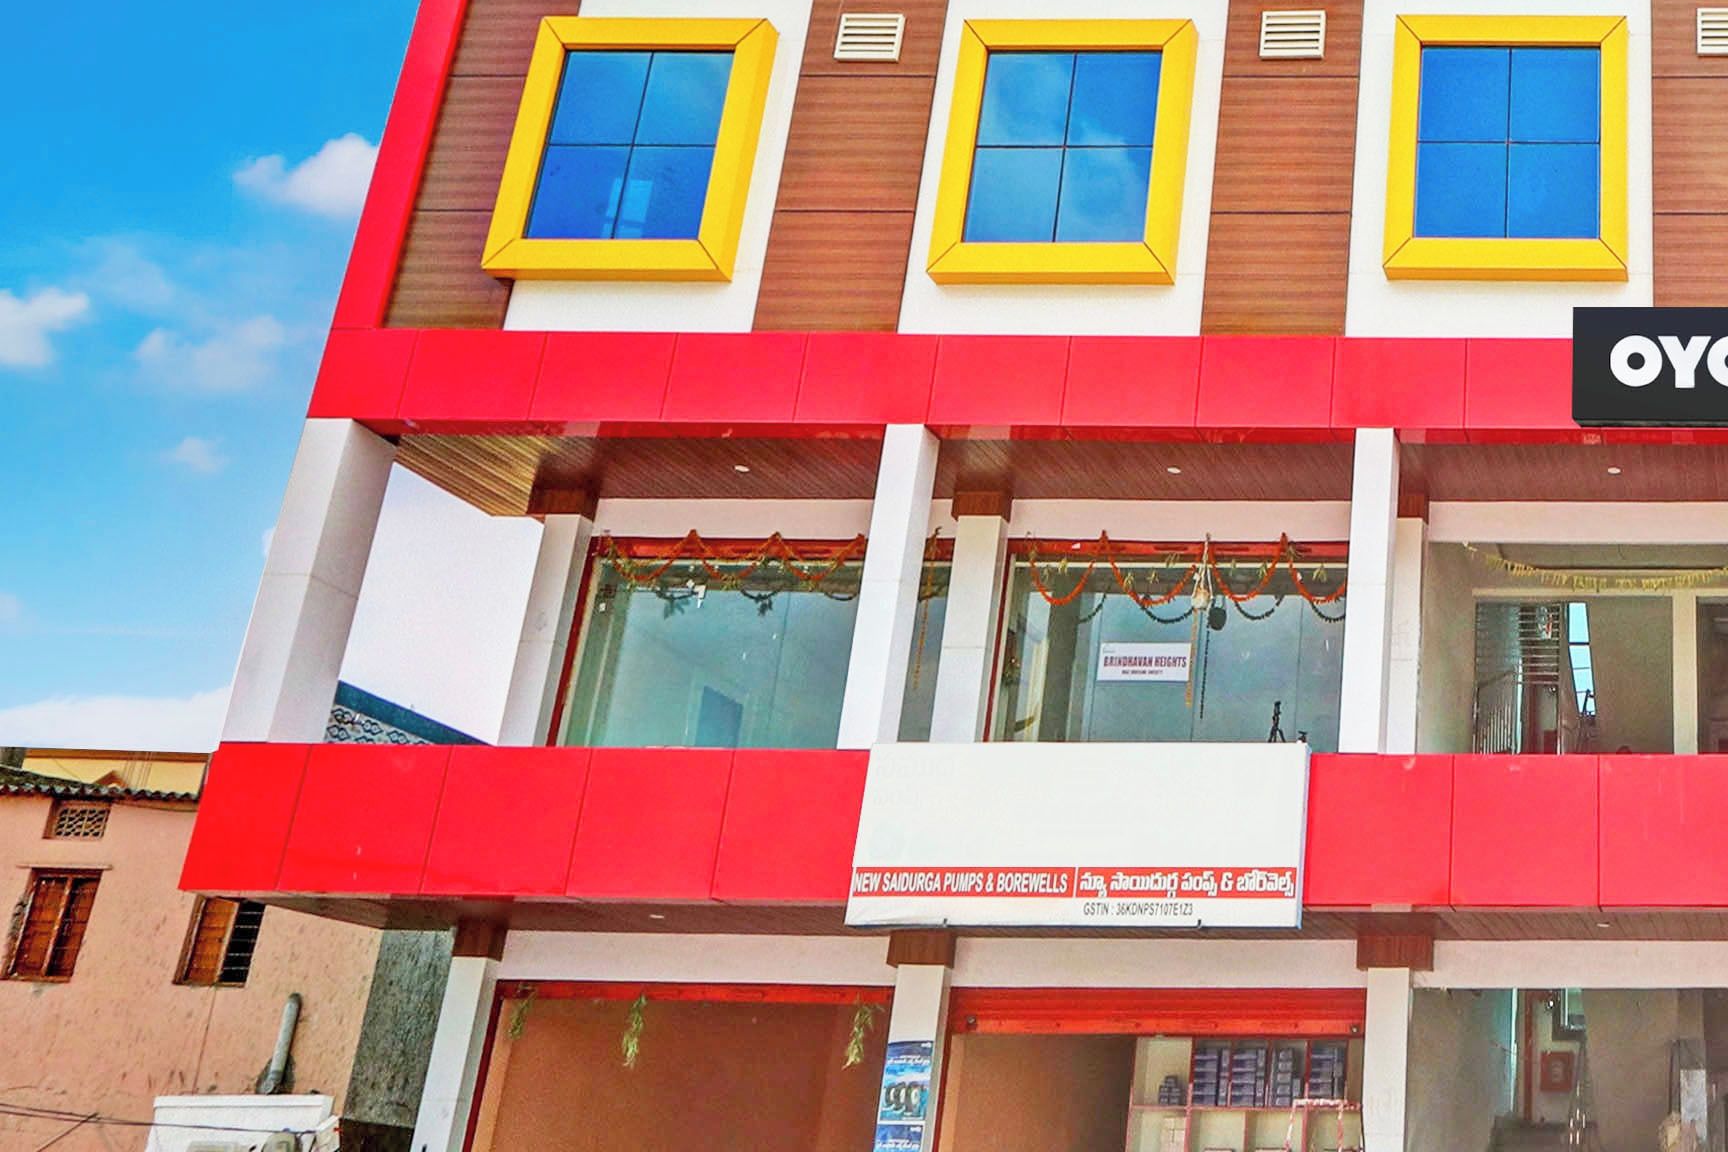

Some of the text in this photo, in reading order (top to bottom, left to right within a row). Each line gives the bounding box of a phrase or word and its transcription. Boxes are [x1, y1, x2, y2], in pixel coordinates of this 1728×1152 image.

[1154, 655, 1187, 668] HEIGHTS
[852, 871, 1068, 894] NEW SAIDURGA PUMPS & BOREWELLS
[1220, 872, 1235, 891] &
[1083, 903, 1110, 916] GSTIN
